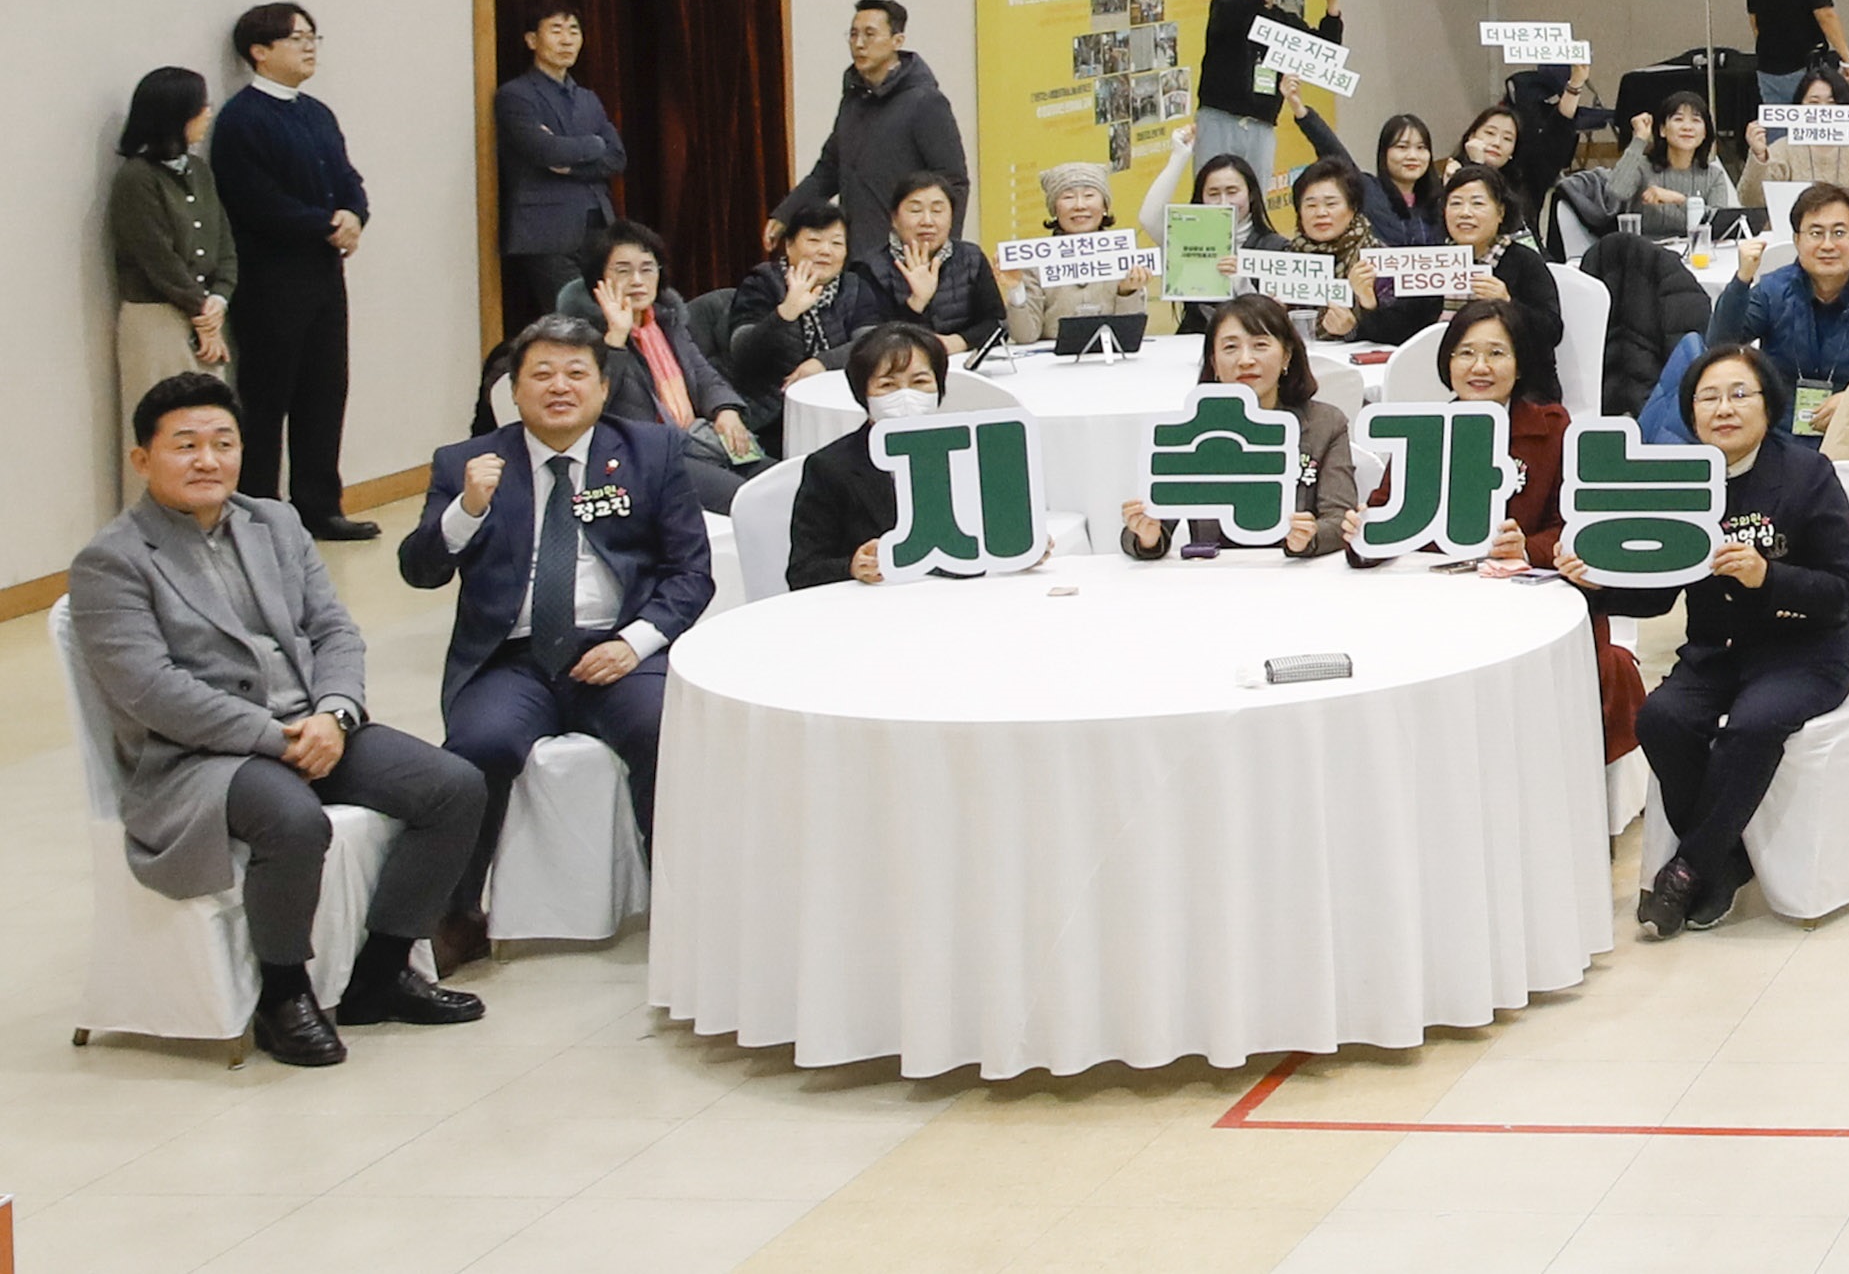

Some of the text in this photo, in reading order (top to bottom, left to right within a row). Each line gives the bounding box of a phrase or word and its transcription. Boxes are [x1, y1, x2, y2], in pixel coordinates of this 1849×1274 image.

[1255, 24, 1271, 41] 더
[1273, 29, 1302, 53] 나은
[1485, 27, 1499, 41] 더
[1503, 27, 1530, 42] 나은
[1509, 44, 1586, 60] 더 나은 사회
[1270, 51, 1353, 91] 더 나은 사회
[1762, 108, 1799, 122] ESG
[1791, 127, 1845, 143] 함께하는
[1003, 234, 1131, 262] ESG 실천으로
[1044, 253, 1156, 282] 함께하는 미래
[1242, 258, 1256, 272] 더
[1259, 258, 1288, 275] 나은
[1366, 252, 1468, 271] 지속가능도시
[1401, 273, 1446, 290] ESG
[1264, 282, 1348, 302] 더 나은 사회
[883, 393, 1716, 574] 지속가능
